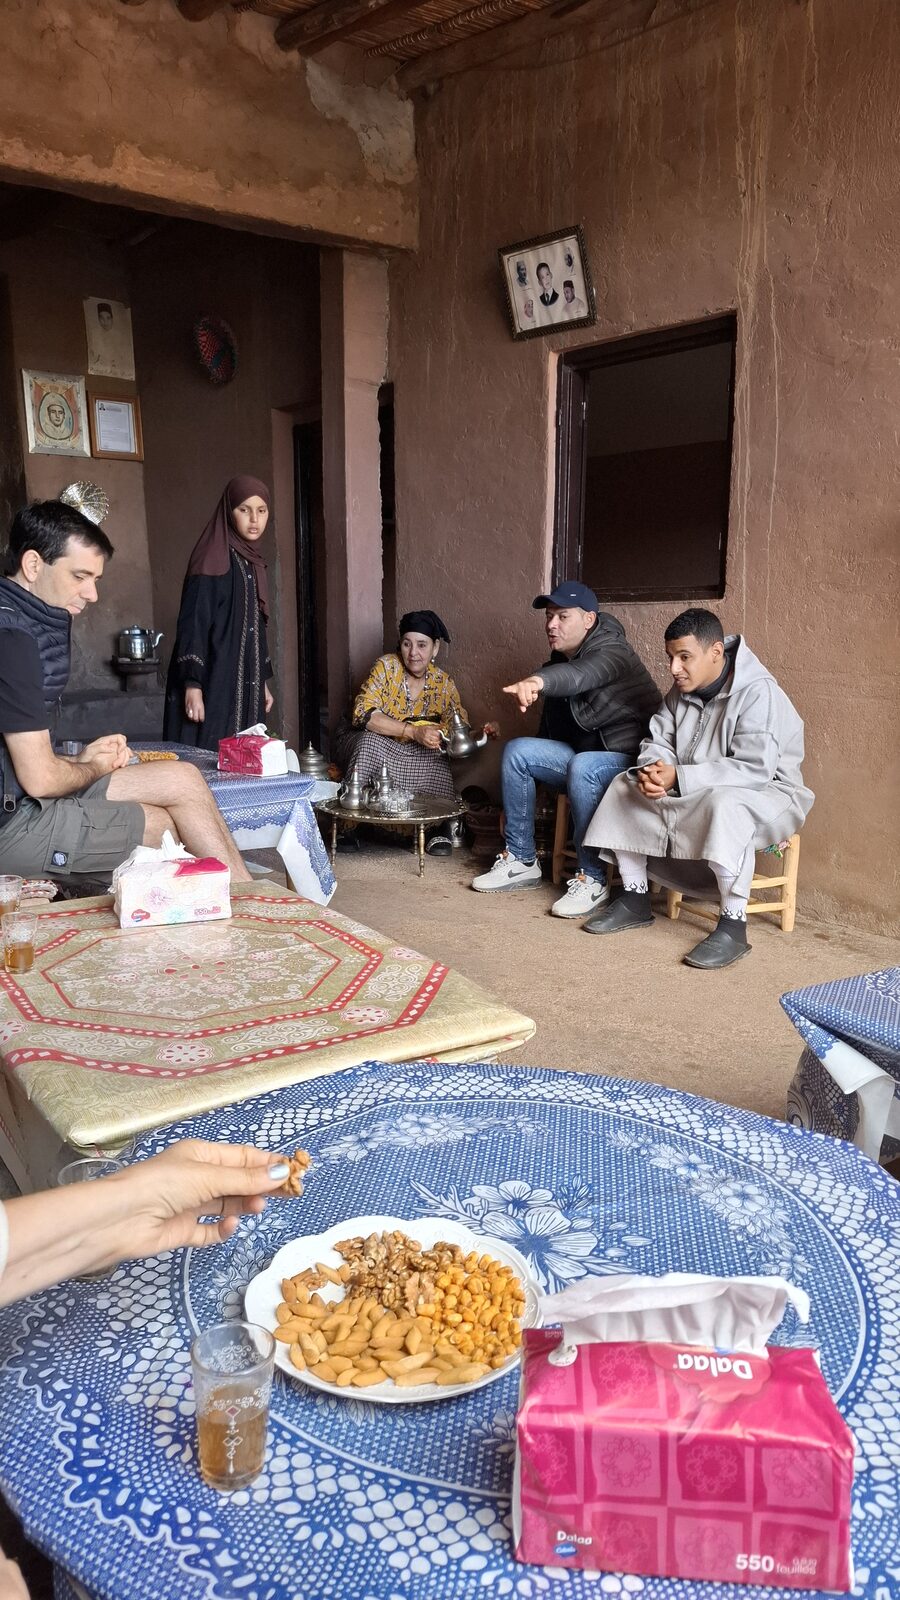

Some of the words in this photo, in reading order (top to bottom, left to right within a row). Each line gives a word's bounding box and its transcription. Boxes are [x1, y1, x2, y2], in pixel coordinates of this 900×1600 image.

[677, 1353, 753, 1380] Dalaa
[556, 1530, 593, 1545] Dalaa
[735, 1553, 775, 1573] 550
